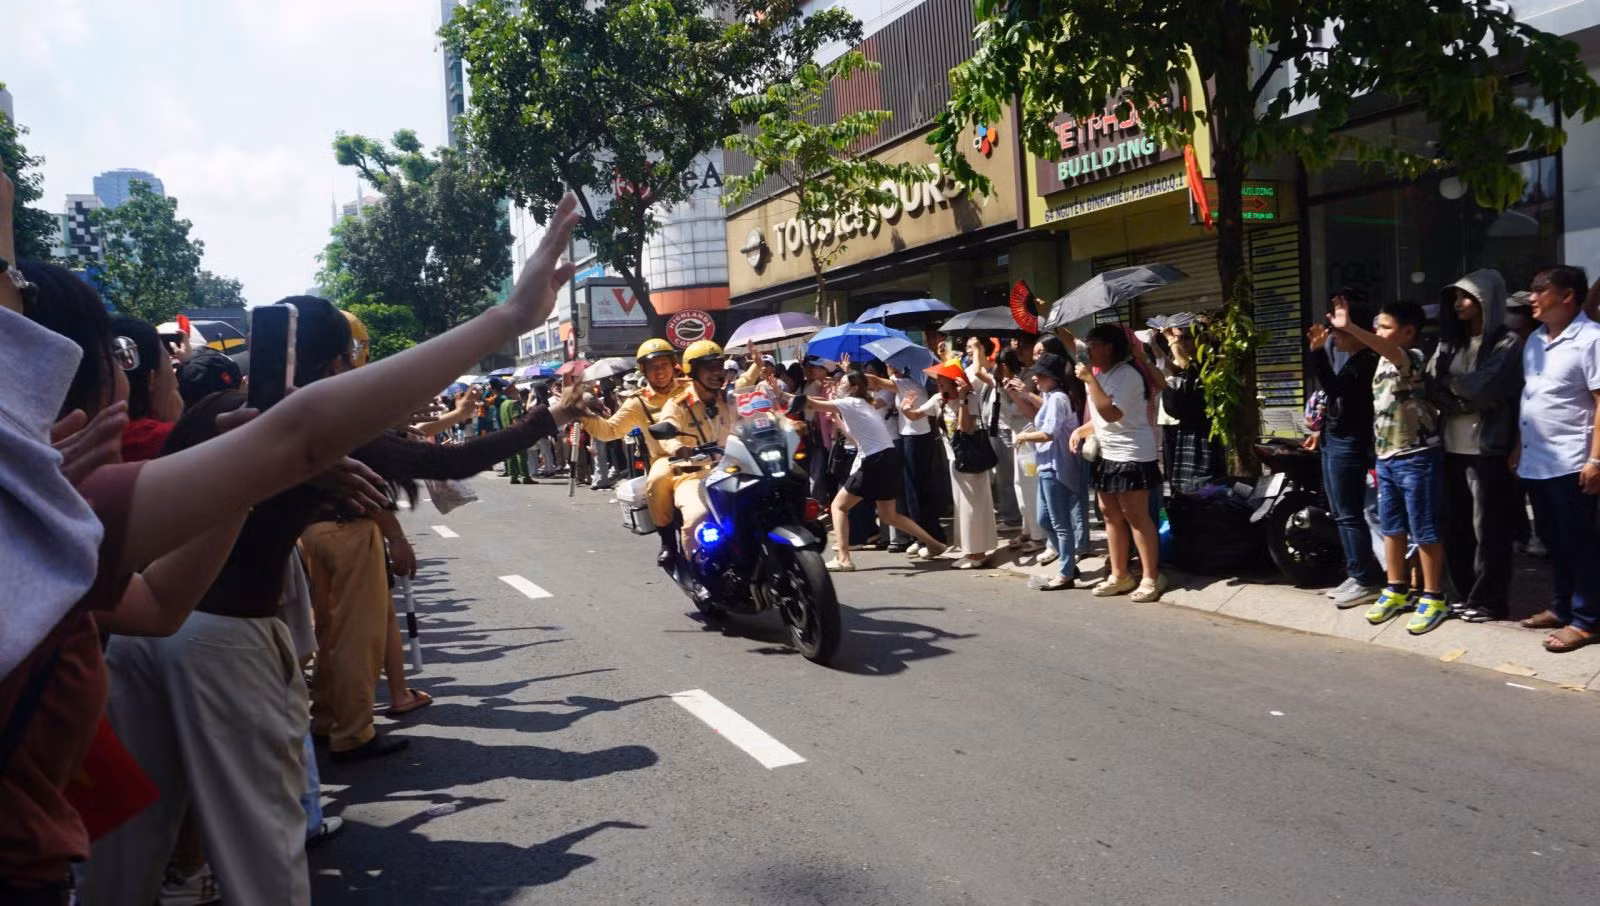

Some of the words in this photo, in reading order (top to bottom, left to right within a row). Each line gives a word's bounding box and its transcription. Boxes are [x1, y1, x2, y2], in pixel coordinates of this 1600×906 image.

[1058, 136, 1155, 181] BUILDING
[1241, 187, 1274, 196] UILDING
[668, 311, 712, 330] HIGHLANDS
